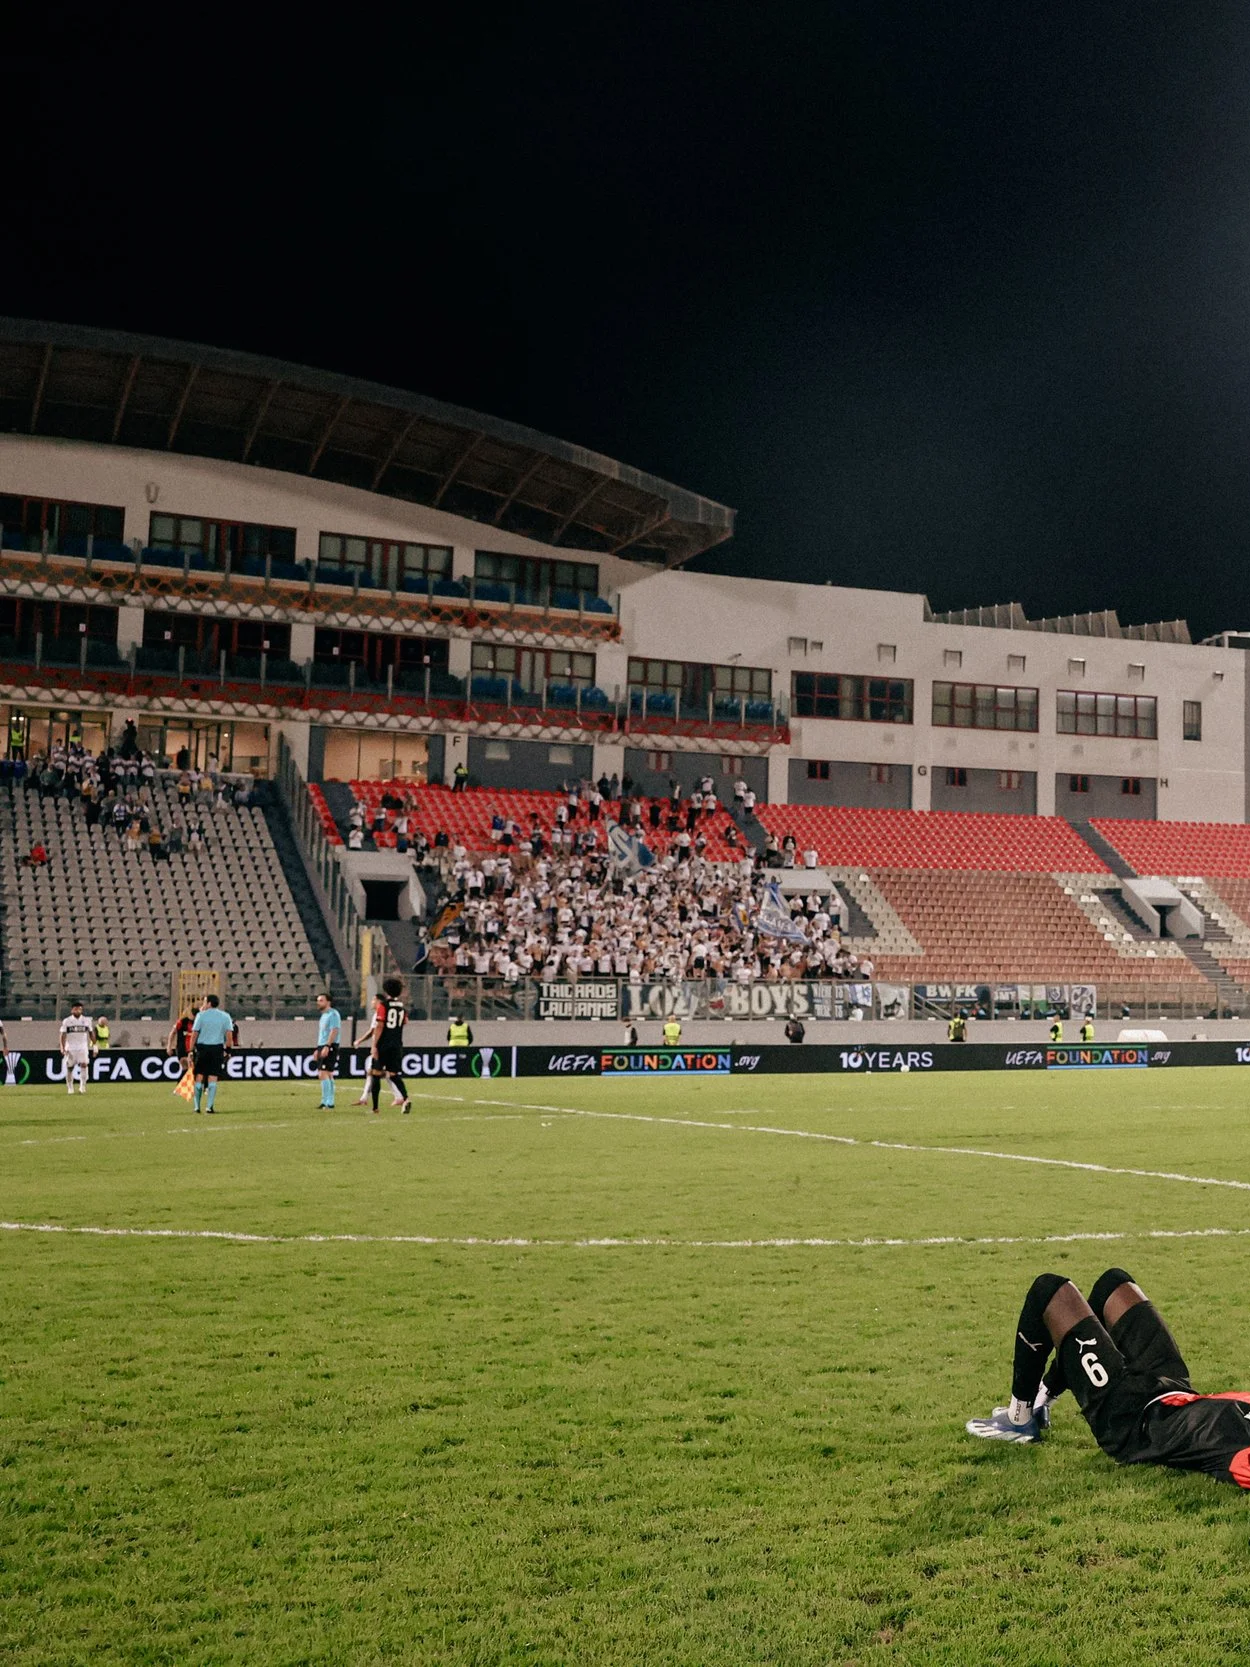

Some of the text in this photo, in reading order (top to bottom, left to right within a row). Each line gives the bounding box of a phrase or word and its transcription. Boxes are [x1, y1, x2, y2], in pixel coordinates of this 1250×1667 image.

[453, 735, 461, 747] F
[917, 765, 928, 776] G
[1160, 777, 1169, 789] H
[386, 1007, 405, 1029] 91
[548, 1054, 598, 1072] UEFA
[1005, 1050, 1043, 1066] UEFA
[46, 1053, 457, 1081] UFA COERENC LGUE
[1081, 1352, 1109, 1388] 6
